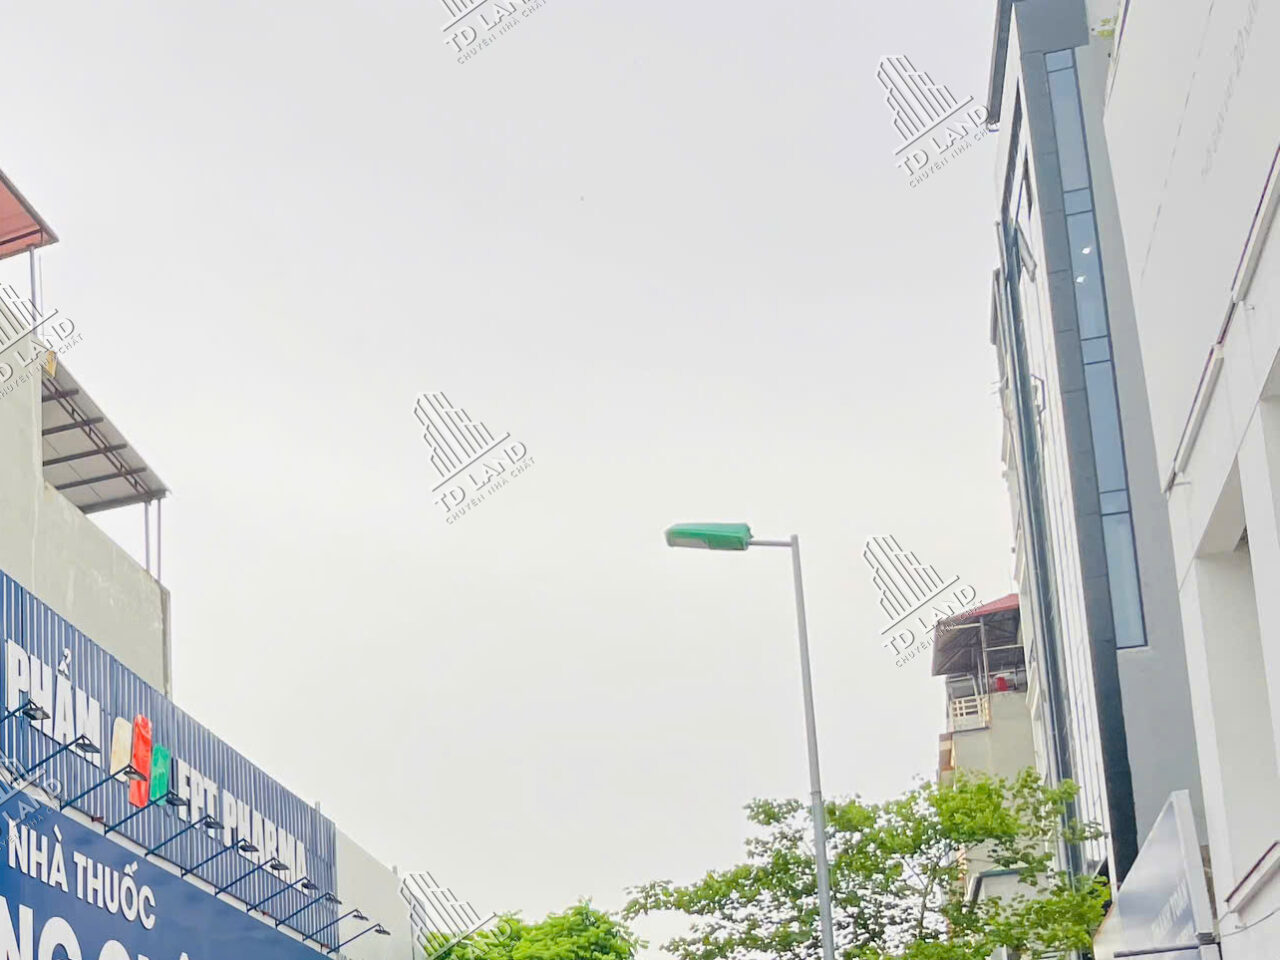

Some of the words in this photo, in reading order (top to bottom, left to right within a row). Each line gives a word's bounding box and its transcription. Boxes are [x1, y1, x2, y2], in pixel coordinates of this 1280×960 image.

[8, 819, 69, 893] NHÀ
[73, 861, 156, 930] THUỐC
[176, 757, 219, 840] FPT
[222, 788, 310, 896] PHARMA
